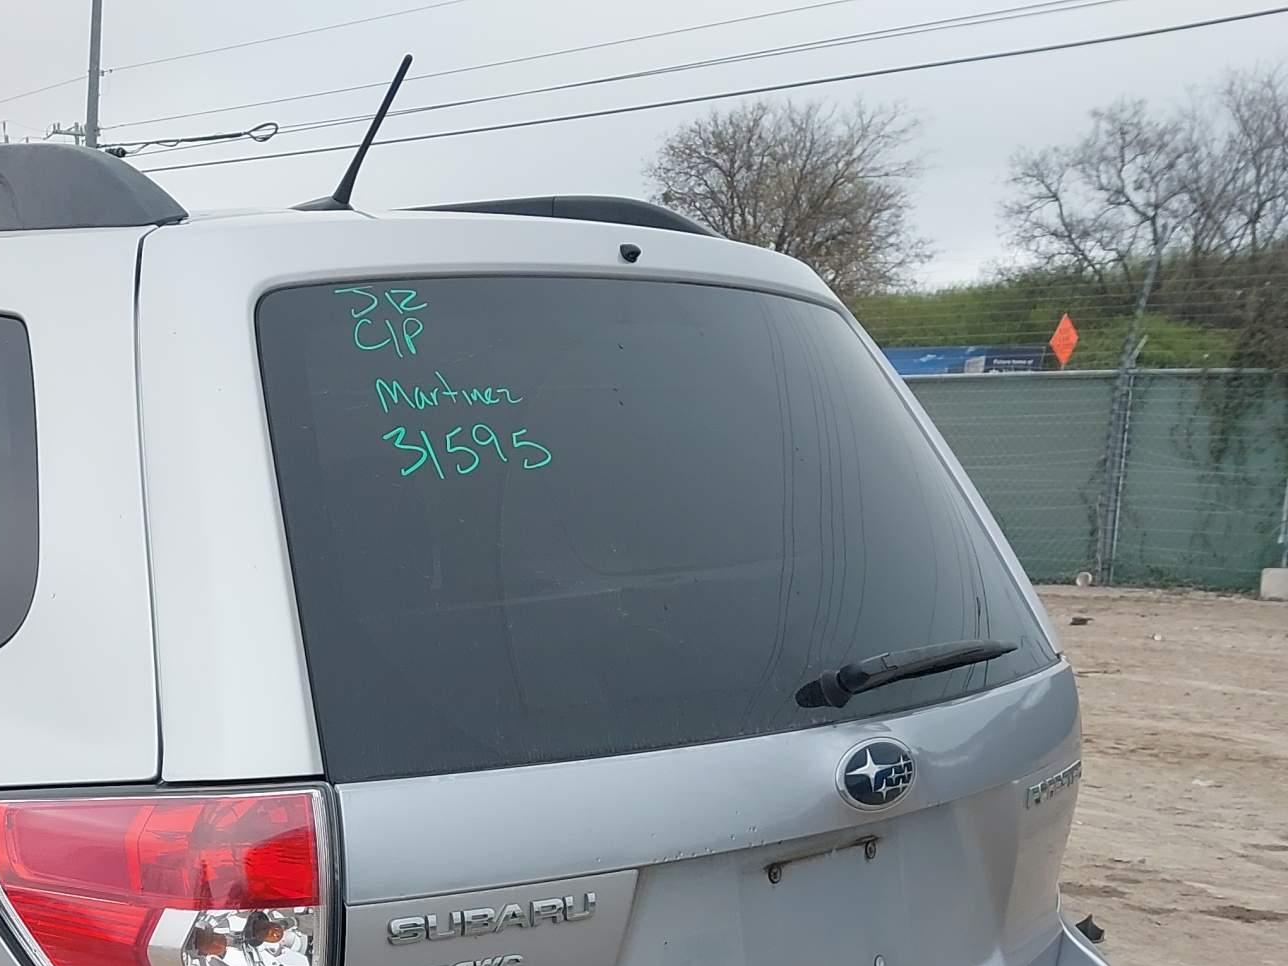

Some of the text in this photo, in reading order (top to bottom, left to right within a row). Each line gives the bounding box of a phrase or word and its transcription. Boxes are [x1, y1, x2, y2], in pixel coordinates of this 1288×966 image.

[375, 371, 523, 413] Martinez
[382, 424, 552, 480] 31595
[387, 891, 597, 946] SUBARU
